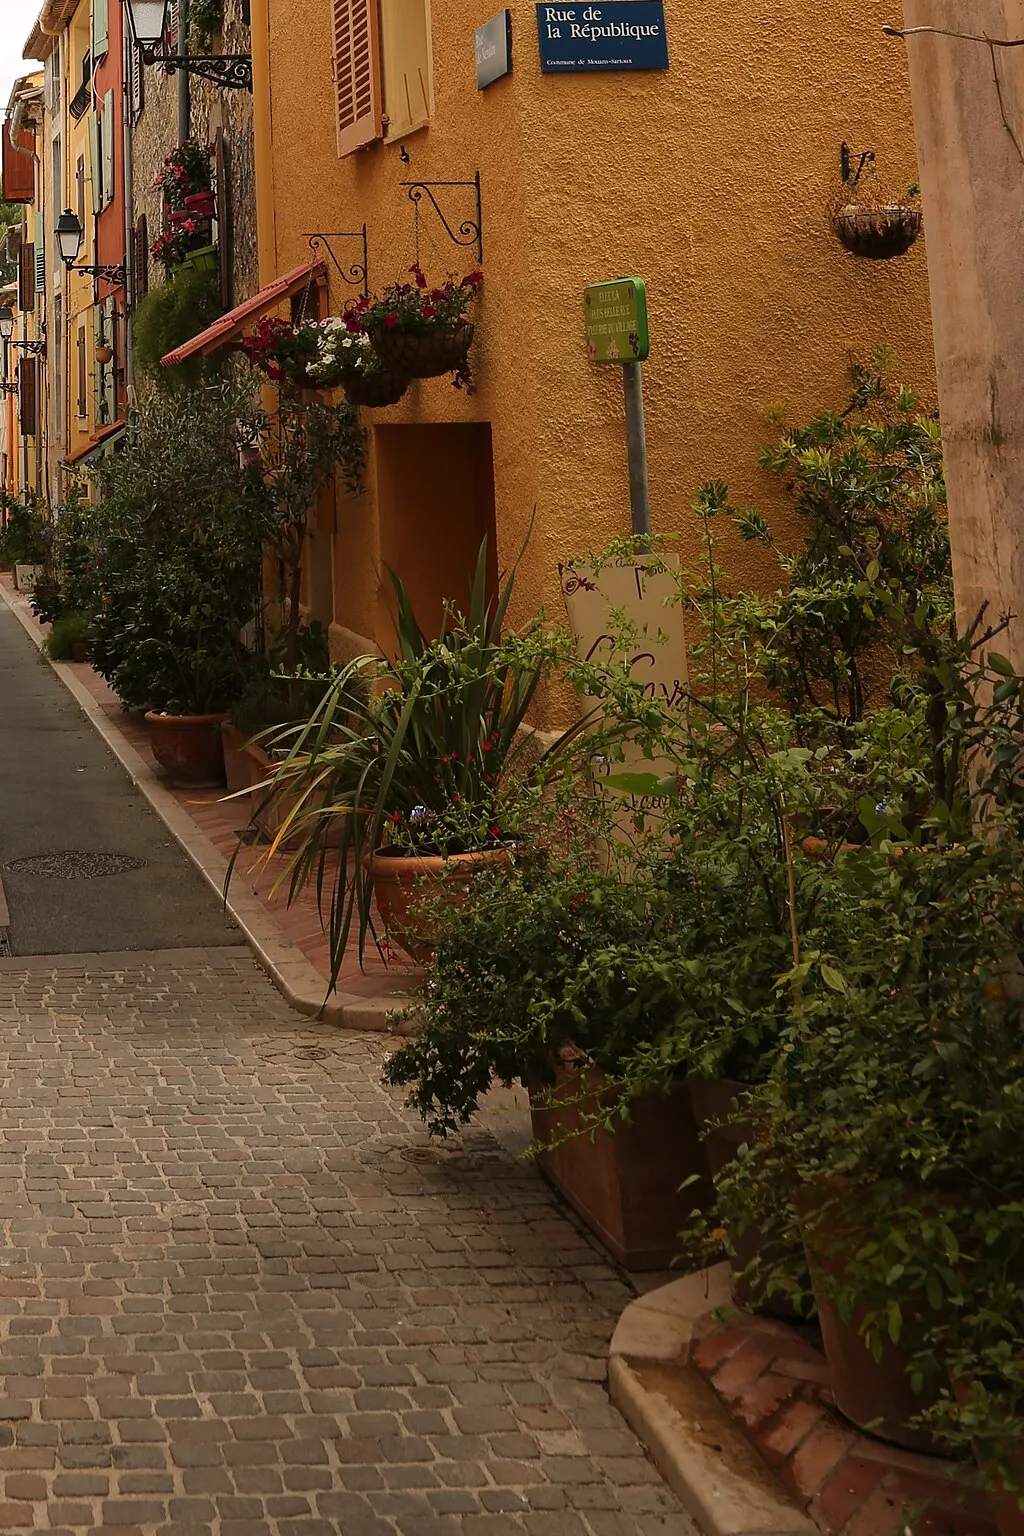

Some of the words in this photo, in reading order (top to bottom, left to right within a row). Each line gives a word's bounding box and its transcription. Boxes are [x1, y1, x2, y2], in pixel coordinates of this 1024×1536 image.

[545, 7, 576, 22] Rue
[582, 6, 602, 21] de
[547, 24, 562, 39] la
[569, 22, 660, 42] République
[577, 58, 585, 66] de
